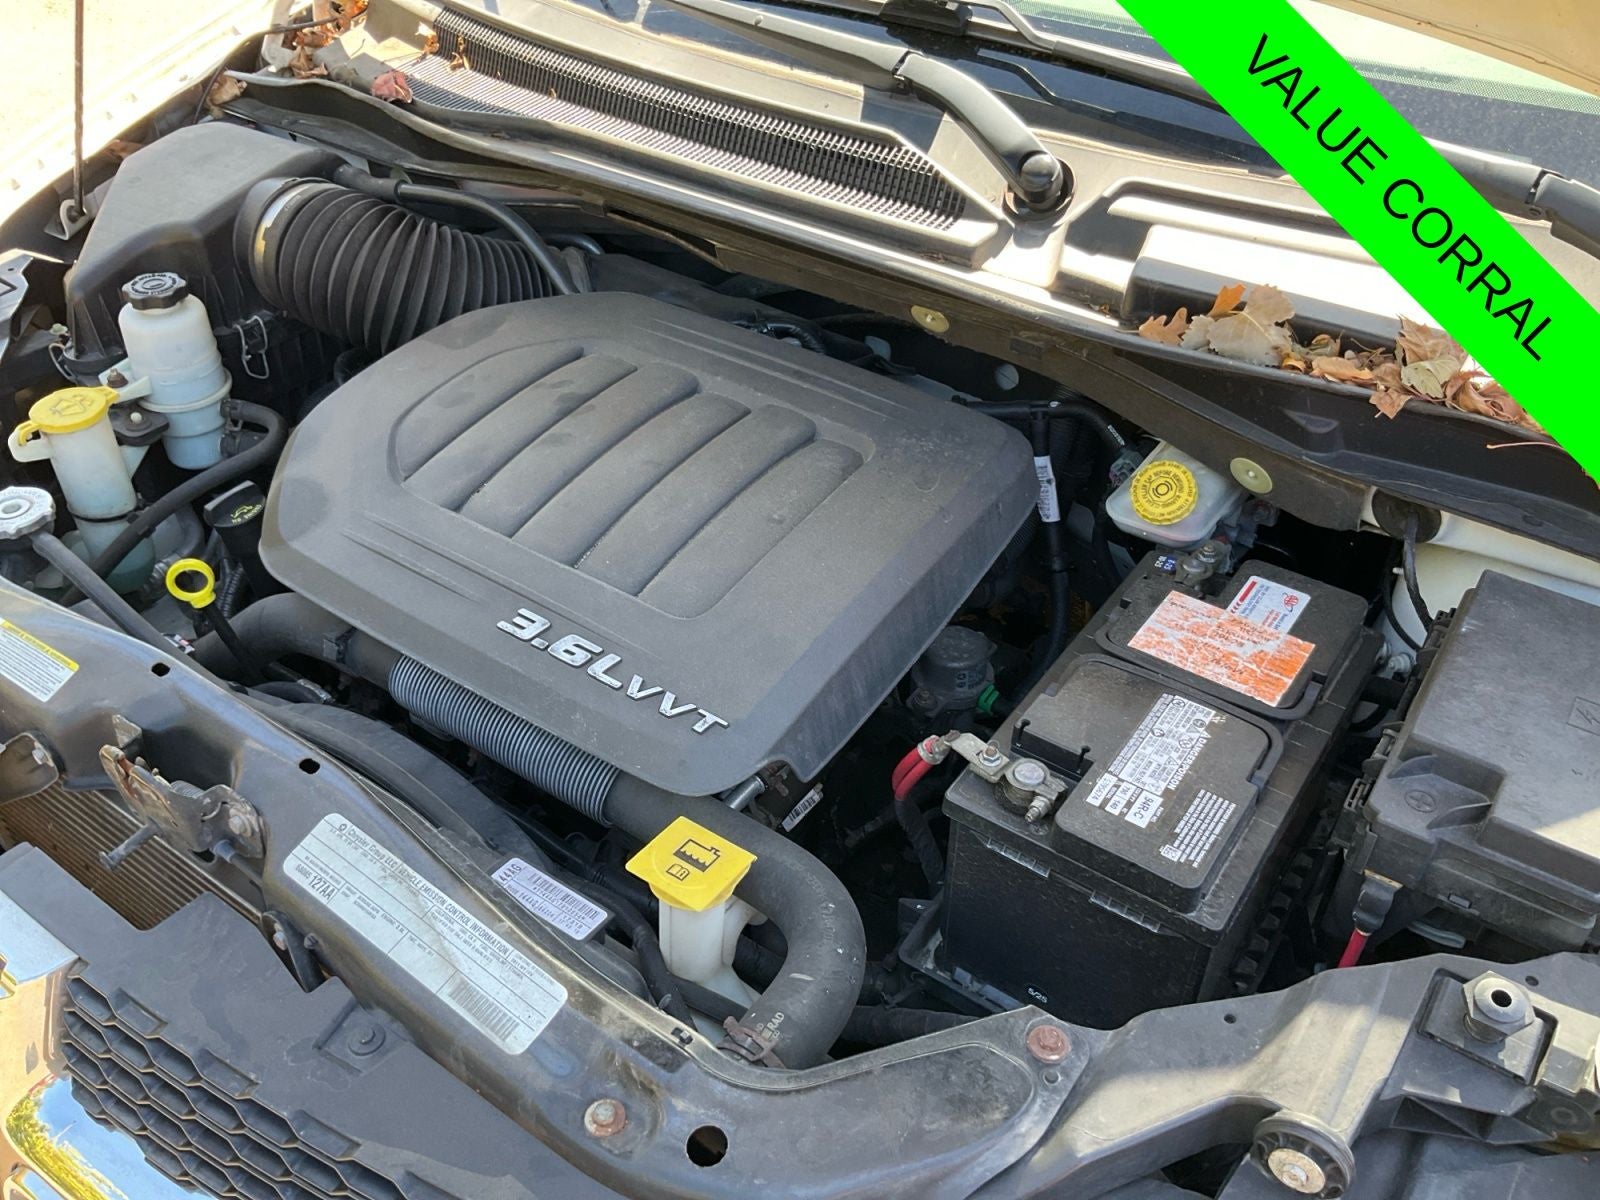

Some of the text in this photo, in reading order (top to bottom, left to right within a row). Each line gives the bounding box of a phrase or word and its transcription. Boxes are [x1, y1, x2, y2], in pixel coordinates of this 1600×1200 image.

[308, 875, 335, 900] 127AA
[346, 827, 370, 847] Chrysler
[368, 844, 385, 861] Group
[385, 855, 398, 869] LLC
[420, 881, 448, 906] EMISSION
[443, 902, 472, 926] CONTROL
[469, 921, 510, 955] INFORMATION
[769, 1011, 785, 1036] RAD
